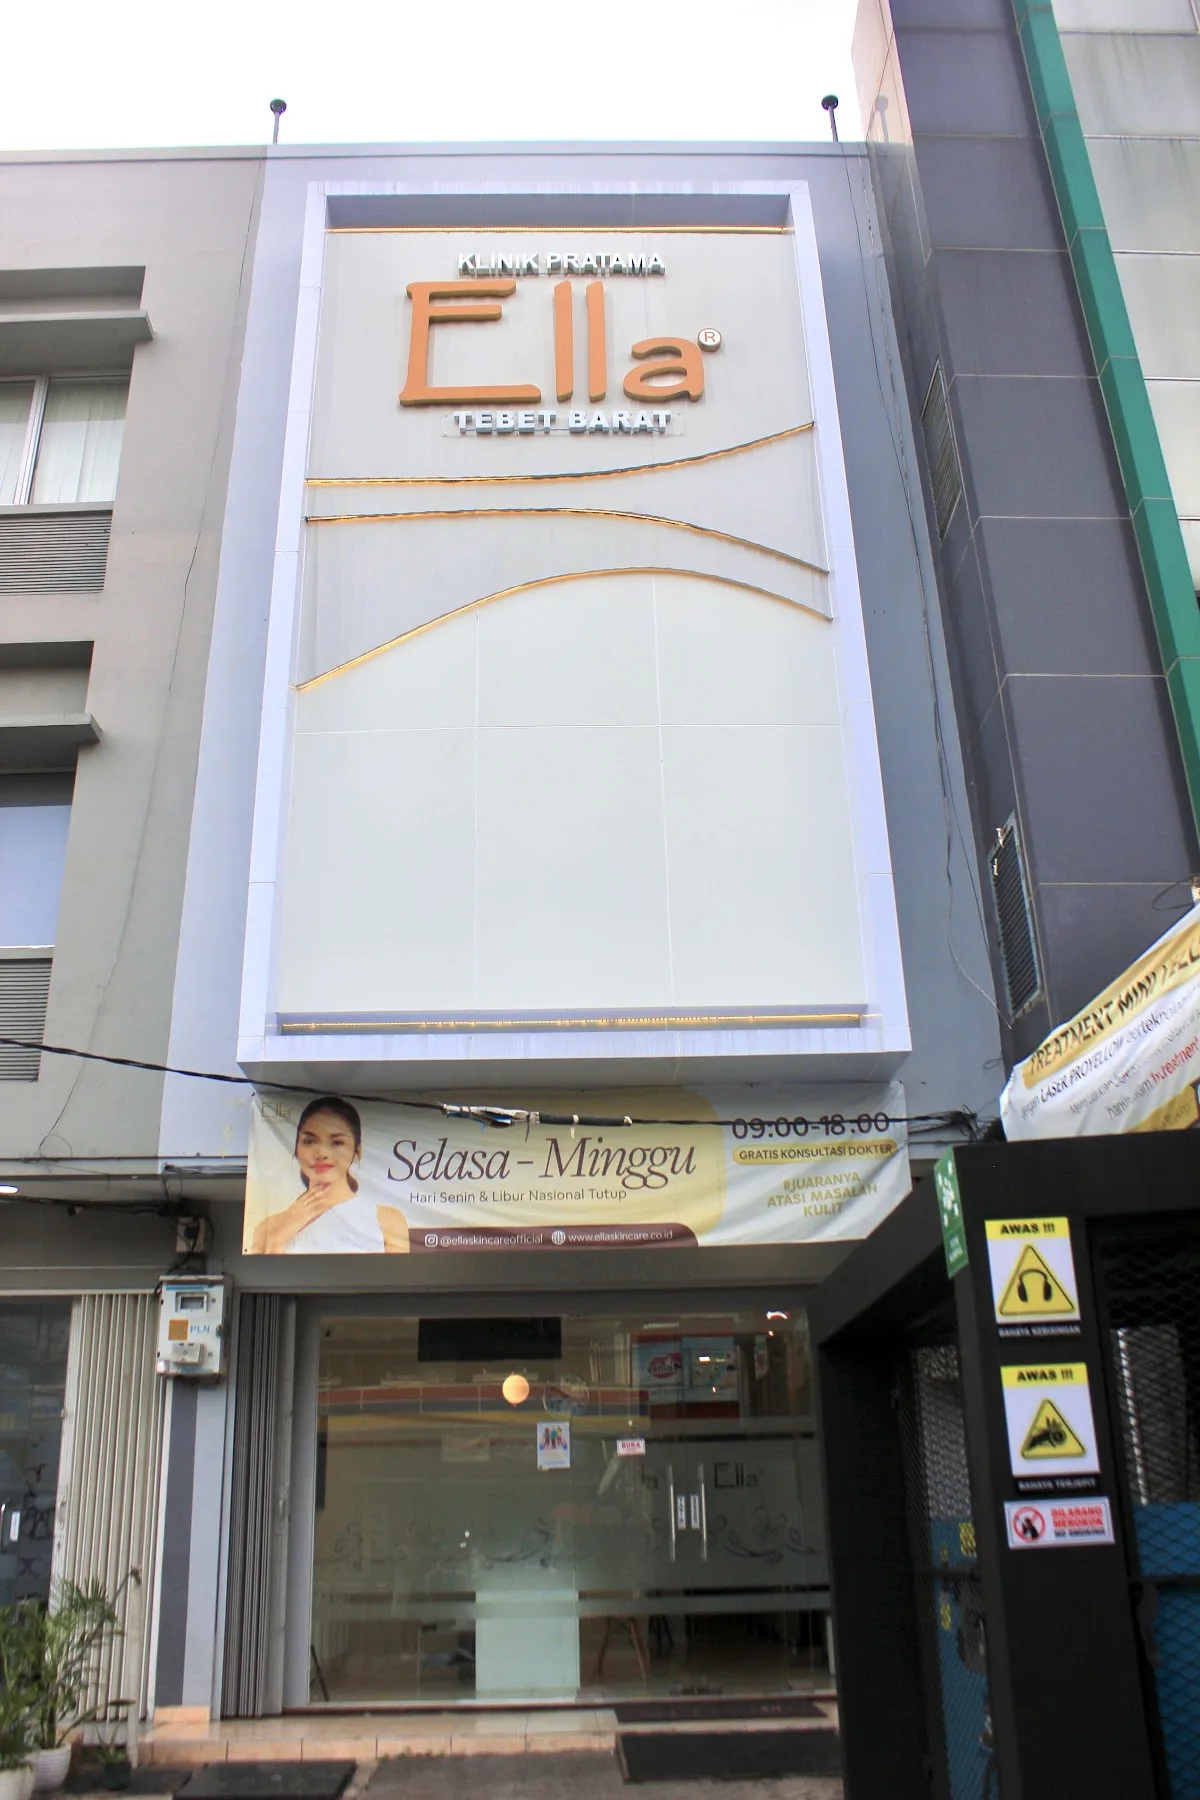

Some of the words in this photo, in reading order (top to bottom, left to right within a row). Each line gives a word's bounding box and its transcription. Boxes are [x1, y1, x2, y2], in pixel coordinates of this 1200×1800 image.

[458, 252, 540, 275] KLINIK
[546, 252, 666, 275] PRATAMA
[399, 279, 706, 407] Ella
[453, 410, 557, 434] TEBET
[568, 410, 672, 434] BARAT
[739, 1149, 779, 1161] GRATIS
[781, 1146, 846, 1159] KONSULTASI
[849, 1143, 893, 1156] DOKTER
[387, 1137, 511, 1182] Selasa
[538, 1136, 697, 1190] Minggu
[782, 1171, 861, 1192] #JUARANYA
[409, 1192, 437, 1204] Hari
[439, 1191, 476, 1204] Senin
[479, 1191, 489, 1203] &
[492, 1190, 526, 1202] Libur
[529, 1189, 584, 1202] Nasional
[588, 1188, 627, 1202] Tutup
[766, 1194, 806, 1208] ATASI
[810, 1183, 878, 1203] MASALAH
[803, 1201, 844, 1217] KULIT
[1000, 1223, 1039, 1235] AWAS
[440, 1233, 543, 1248] @ellaskincareofficial
[568, 1230, 673, 1242] www.ellaskincare.co.id
[190, 1324, 211, 1333] PLN
[1017, 1369, 1057, 1382] AWAS
